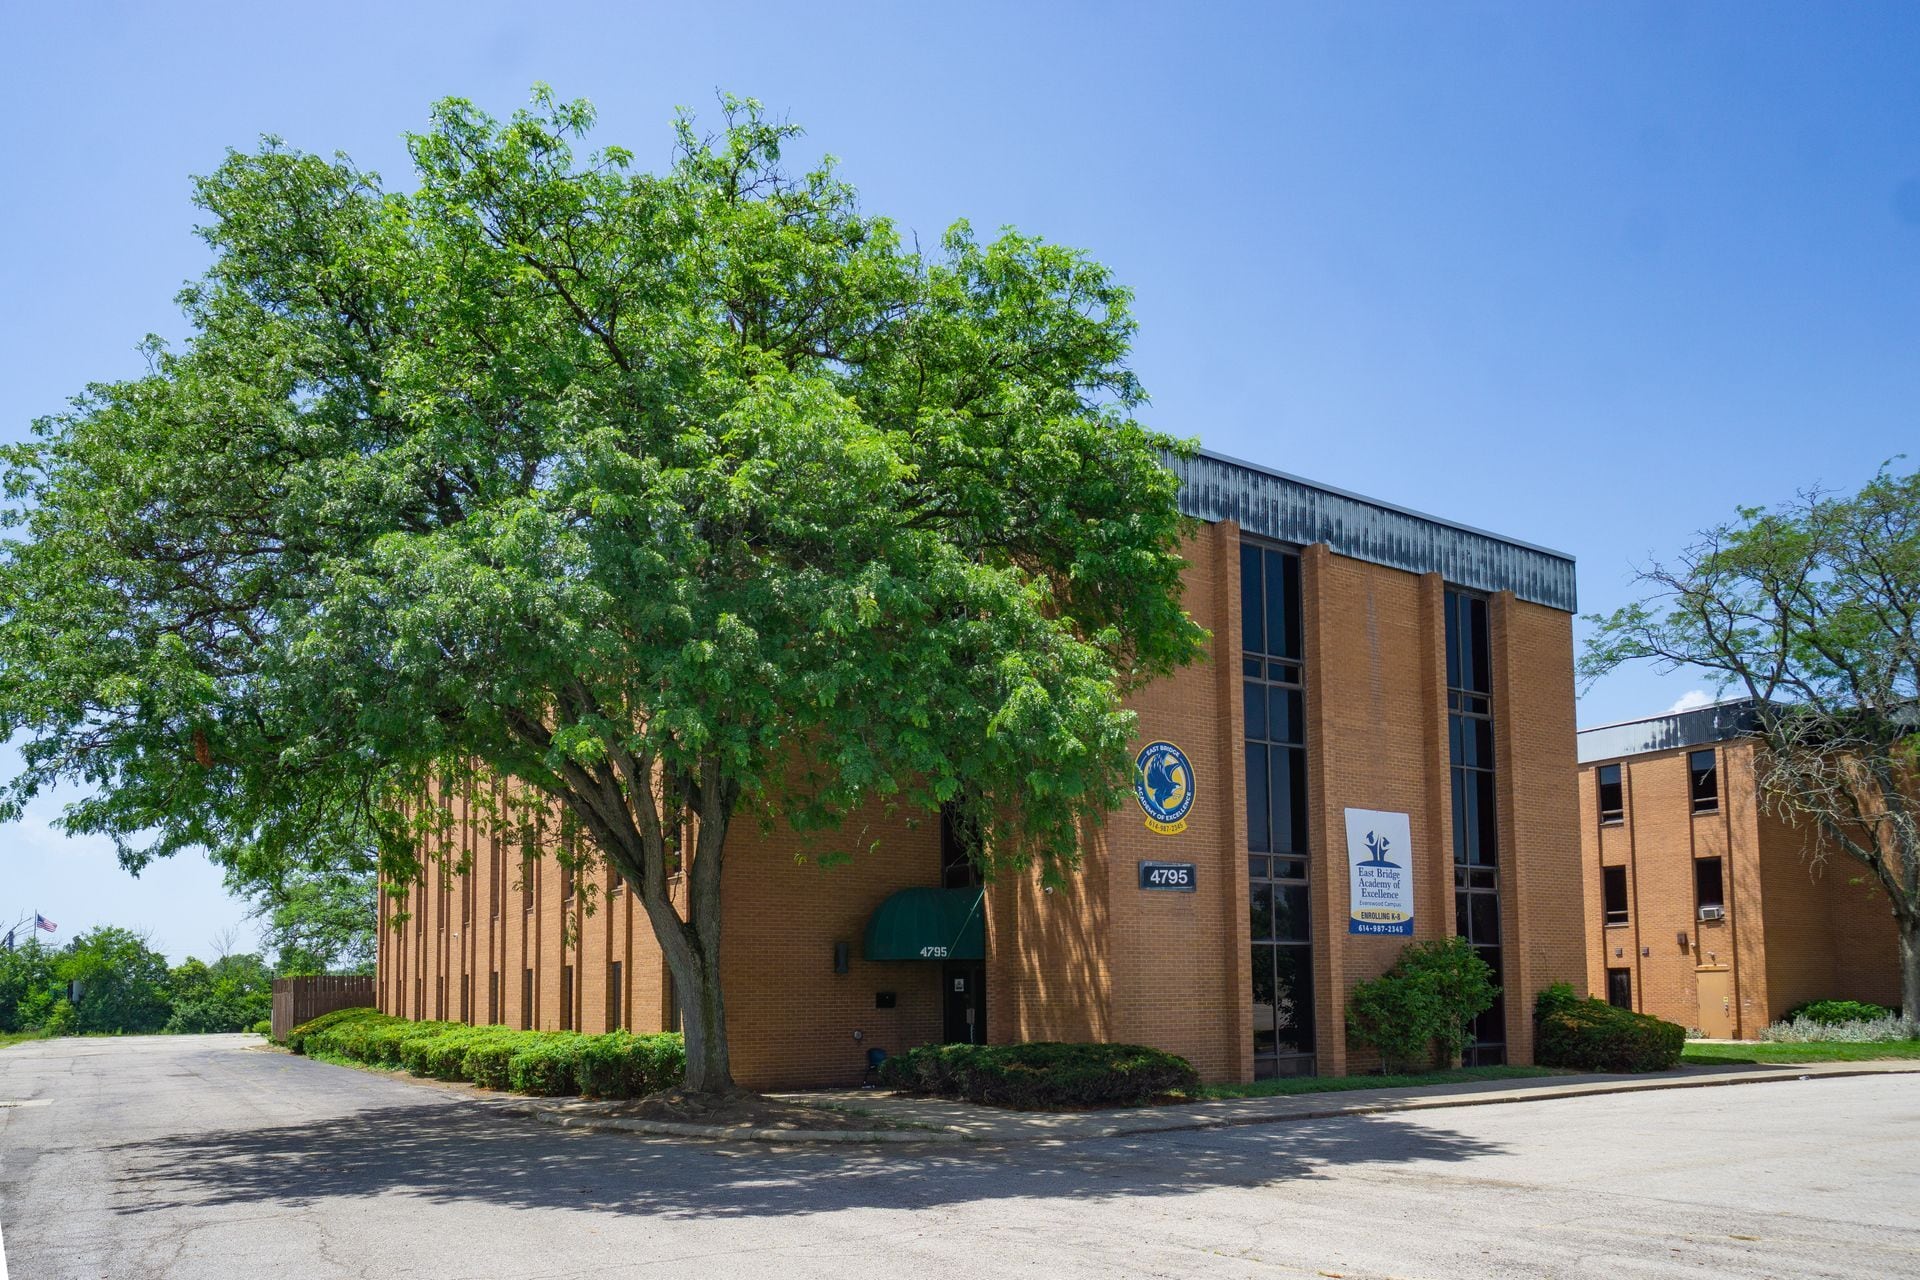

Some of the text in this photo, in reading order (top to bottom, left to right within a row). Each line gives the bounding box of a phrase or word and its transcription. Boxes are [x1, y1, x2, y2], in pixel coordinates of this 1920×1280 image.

[1146, 745, 1180, 758] EAST BRIDGE
[1138, 786, 1192, 821] ACADEMY OF EXCELLENCE
[1150, 869, 1188, 884] 4795
[1358, 867, 1400, 880] East Bridge
[1358, 878, 1401, 889] Academy of
[1361, 888, 1399, 899] Excellence
[1361, 912, 1401, 921] ENROLLING K-8
[1358, 925, 1403, 933] 614-987-2345
[920, 946, 947, 957] 4795
